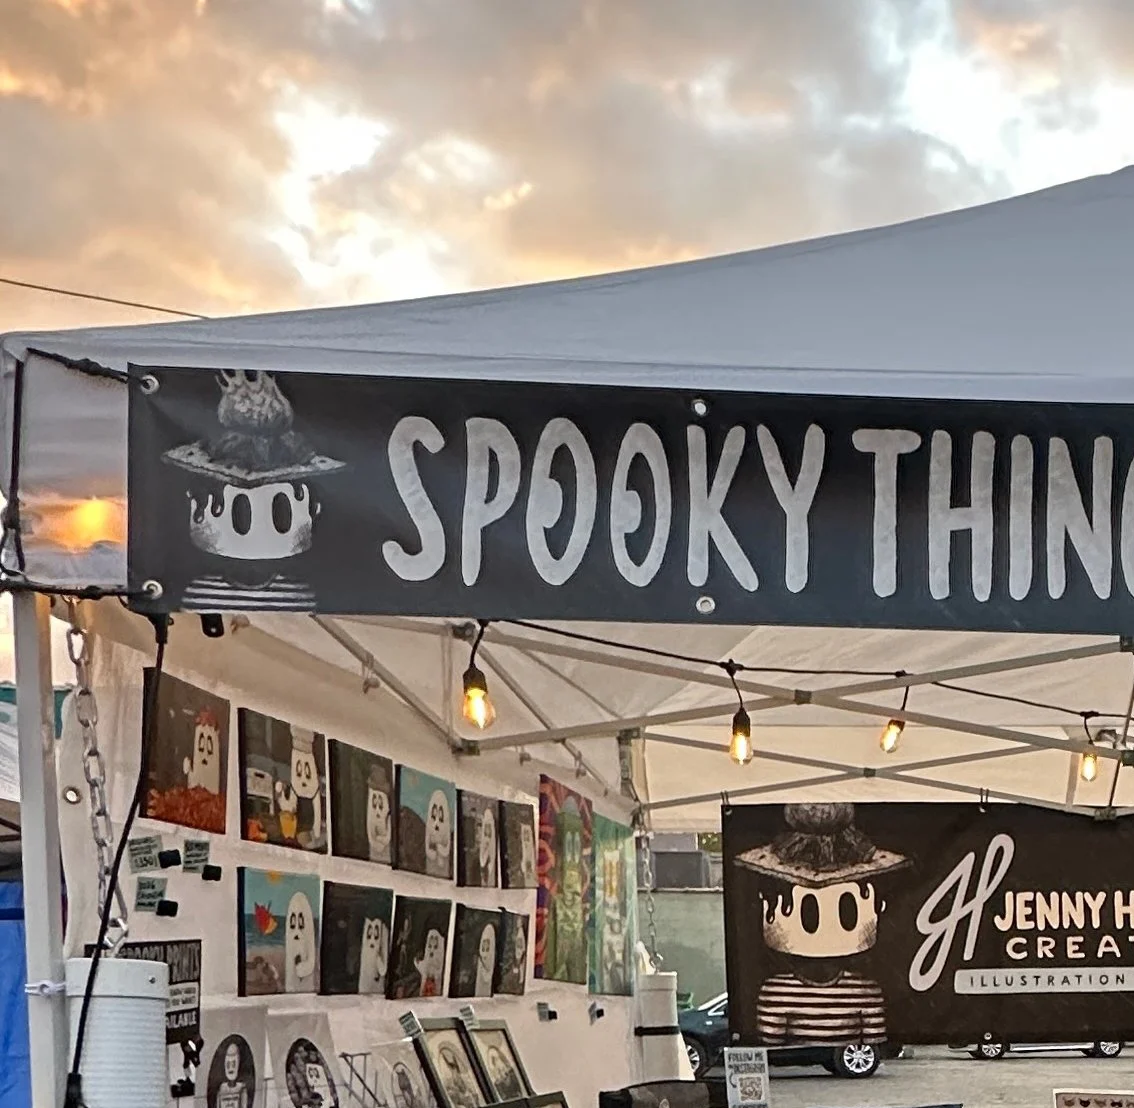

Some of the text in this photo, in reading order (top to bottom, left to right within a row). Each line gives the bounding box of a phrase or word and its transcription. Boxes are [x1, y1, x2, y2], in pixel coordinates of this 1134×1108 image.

[382, 415, 826, 593] SPOOKY
[994, 890, 1107, 932] JENNY
[969, 974, 1126, 988] ILLUSTRATION
